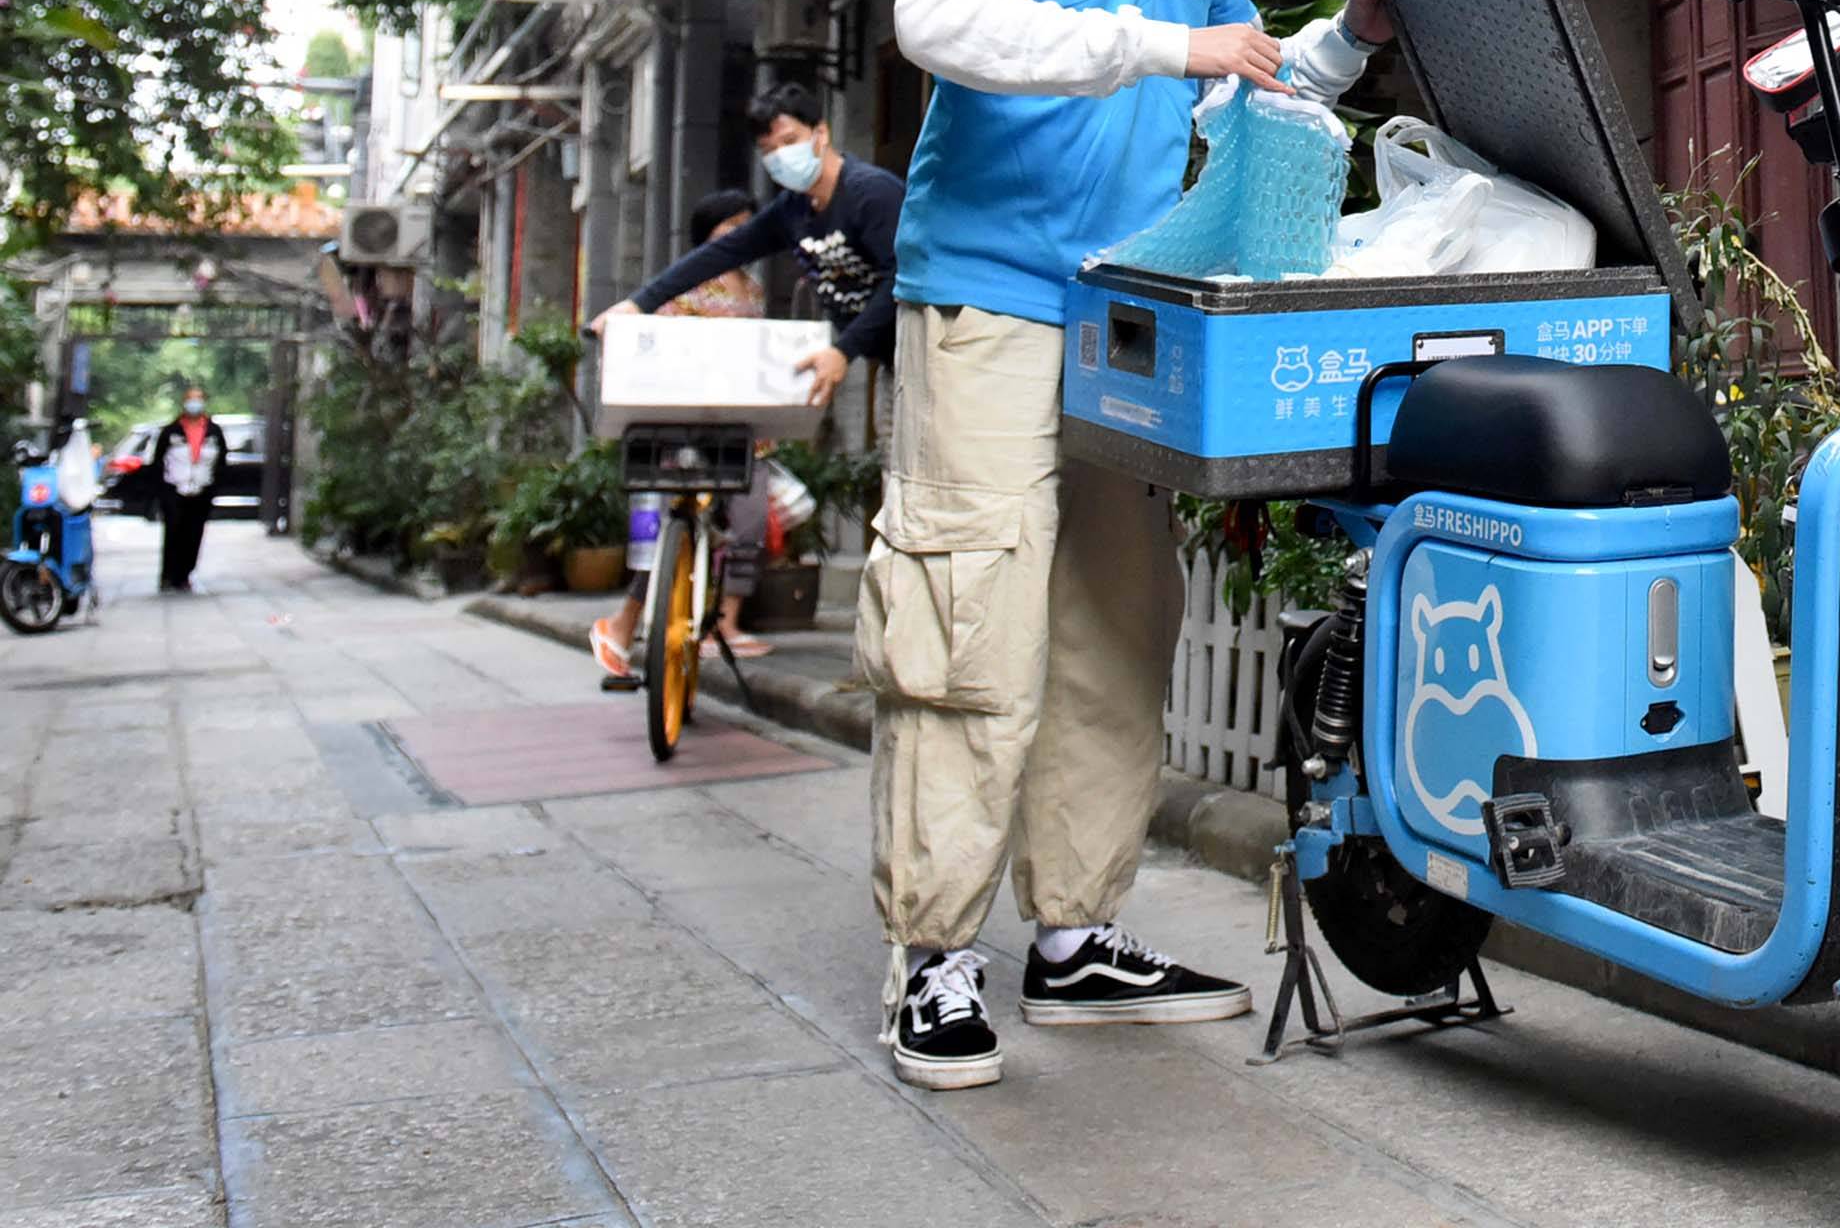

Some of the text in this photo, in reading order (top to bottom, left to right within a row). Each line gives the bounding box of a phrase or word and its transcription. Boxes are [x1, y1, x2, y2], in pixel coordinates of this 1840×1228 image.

[1317, 348, 1372, 384] 盒马
[1274, 393, 1357, 420] 鲜美生
